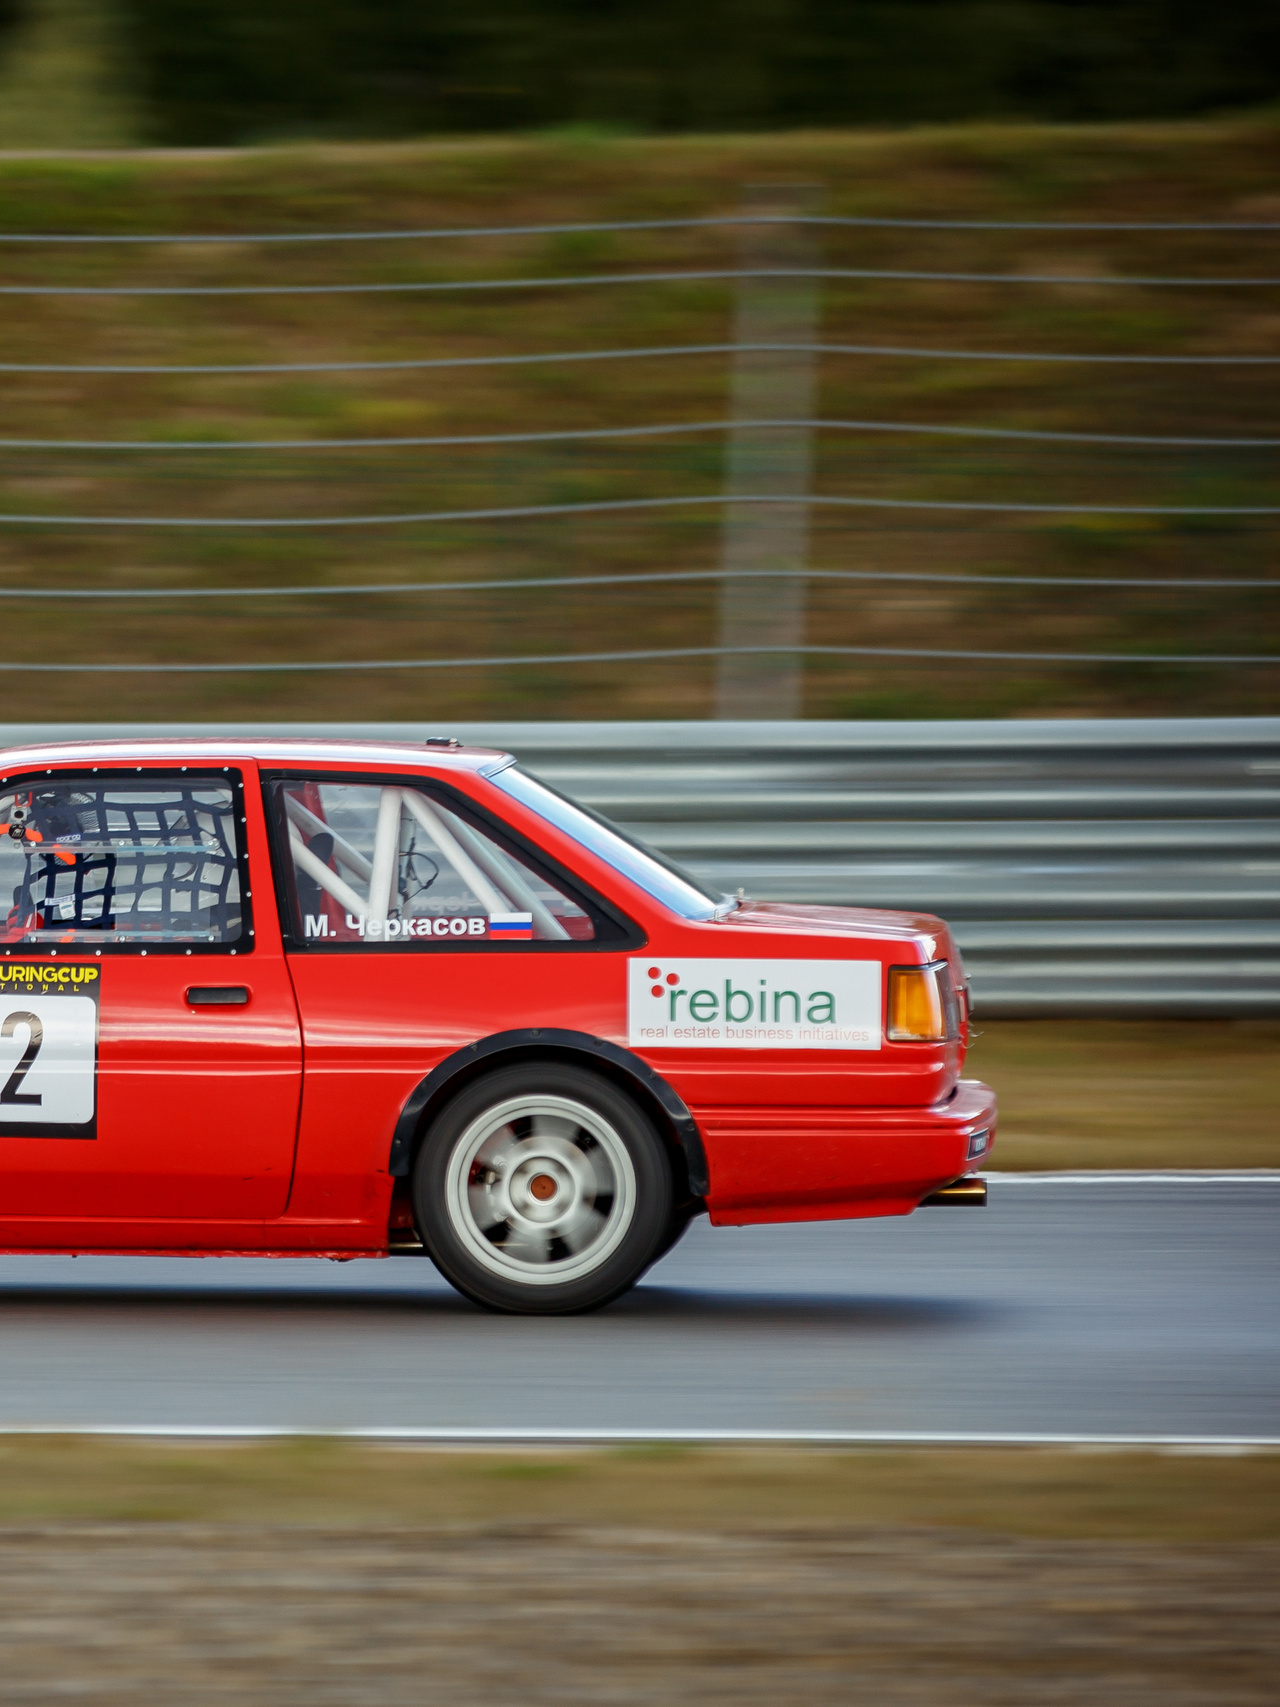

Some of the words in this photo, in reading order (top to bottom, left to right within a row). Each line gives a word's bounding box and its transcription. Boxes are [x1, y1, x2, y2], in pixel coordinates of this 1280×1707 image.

[305, 914, 337, 937] М.
[345, 913, 486, 940] Черкасов
[669, 979, 837, 1024] rebina
[640, 1025, 669, 1038] real
[674, 1026, 721, 1039] estate
[726, 1026, 794, 1040] business
[799, 1027, 870, 1041] initiatives
